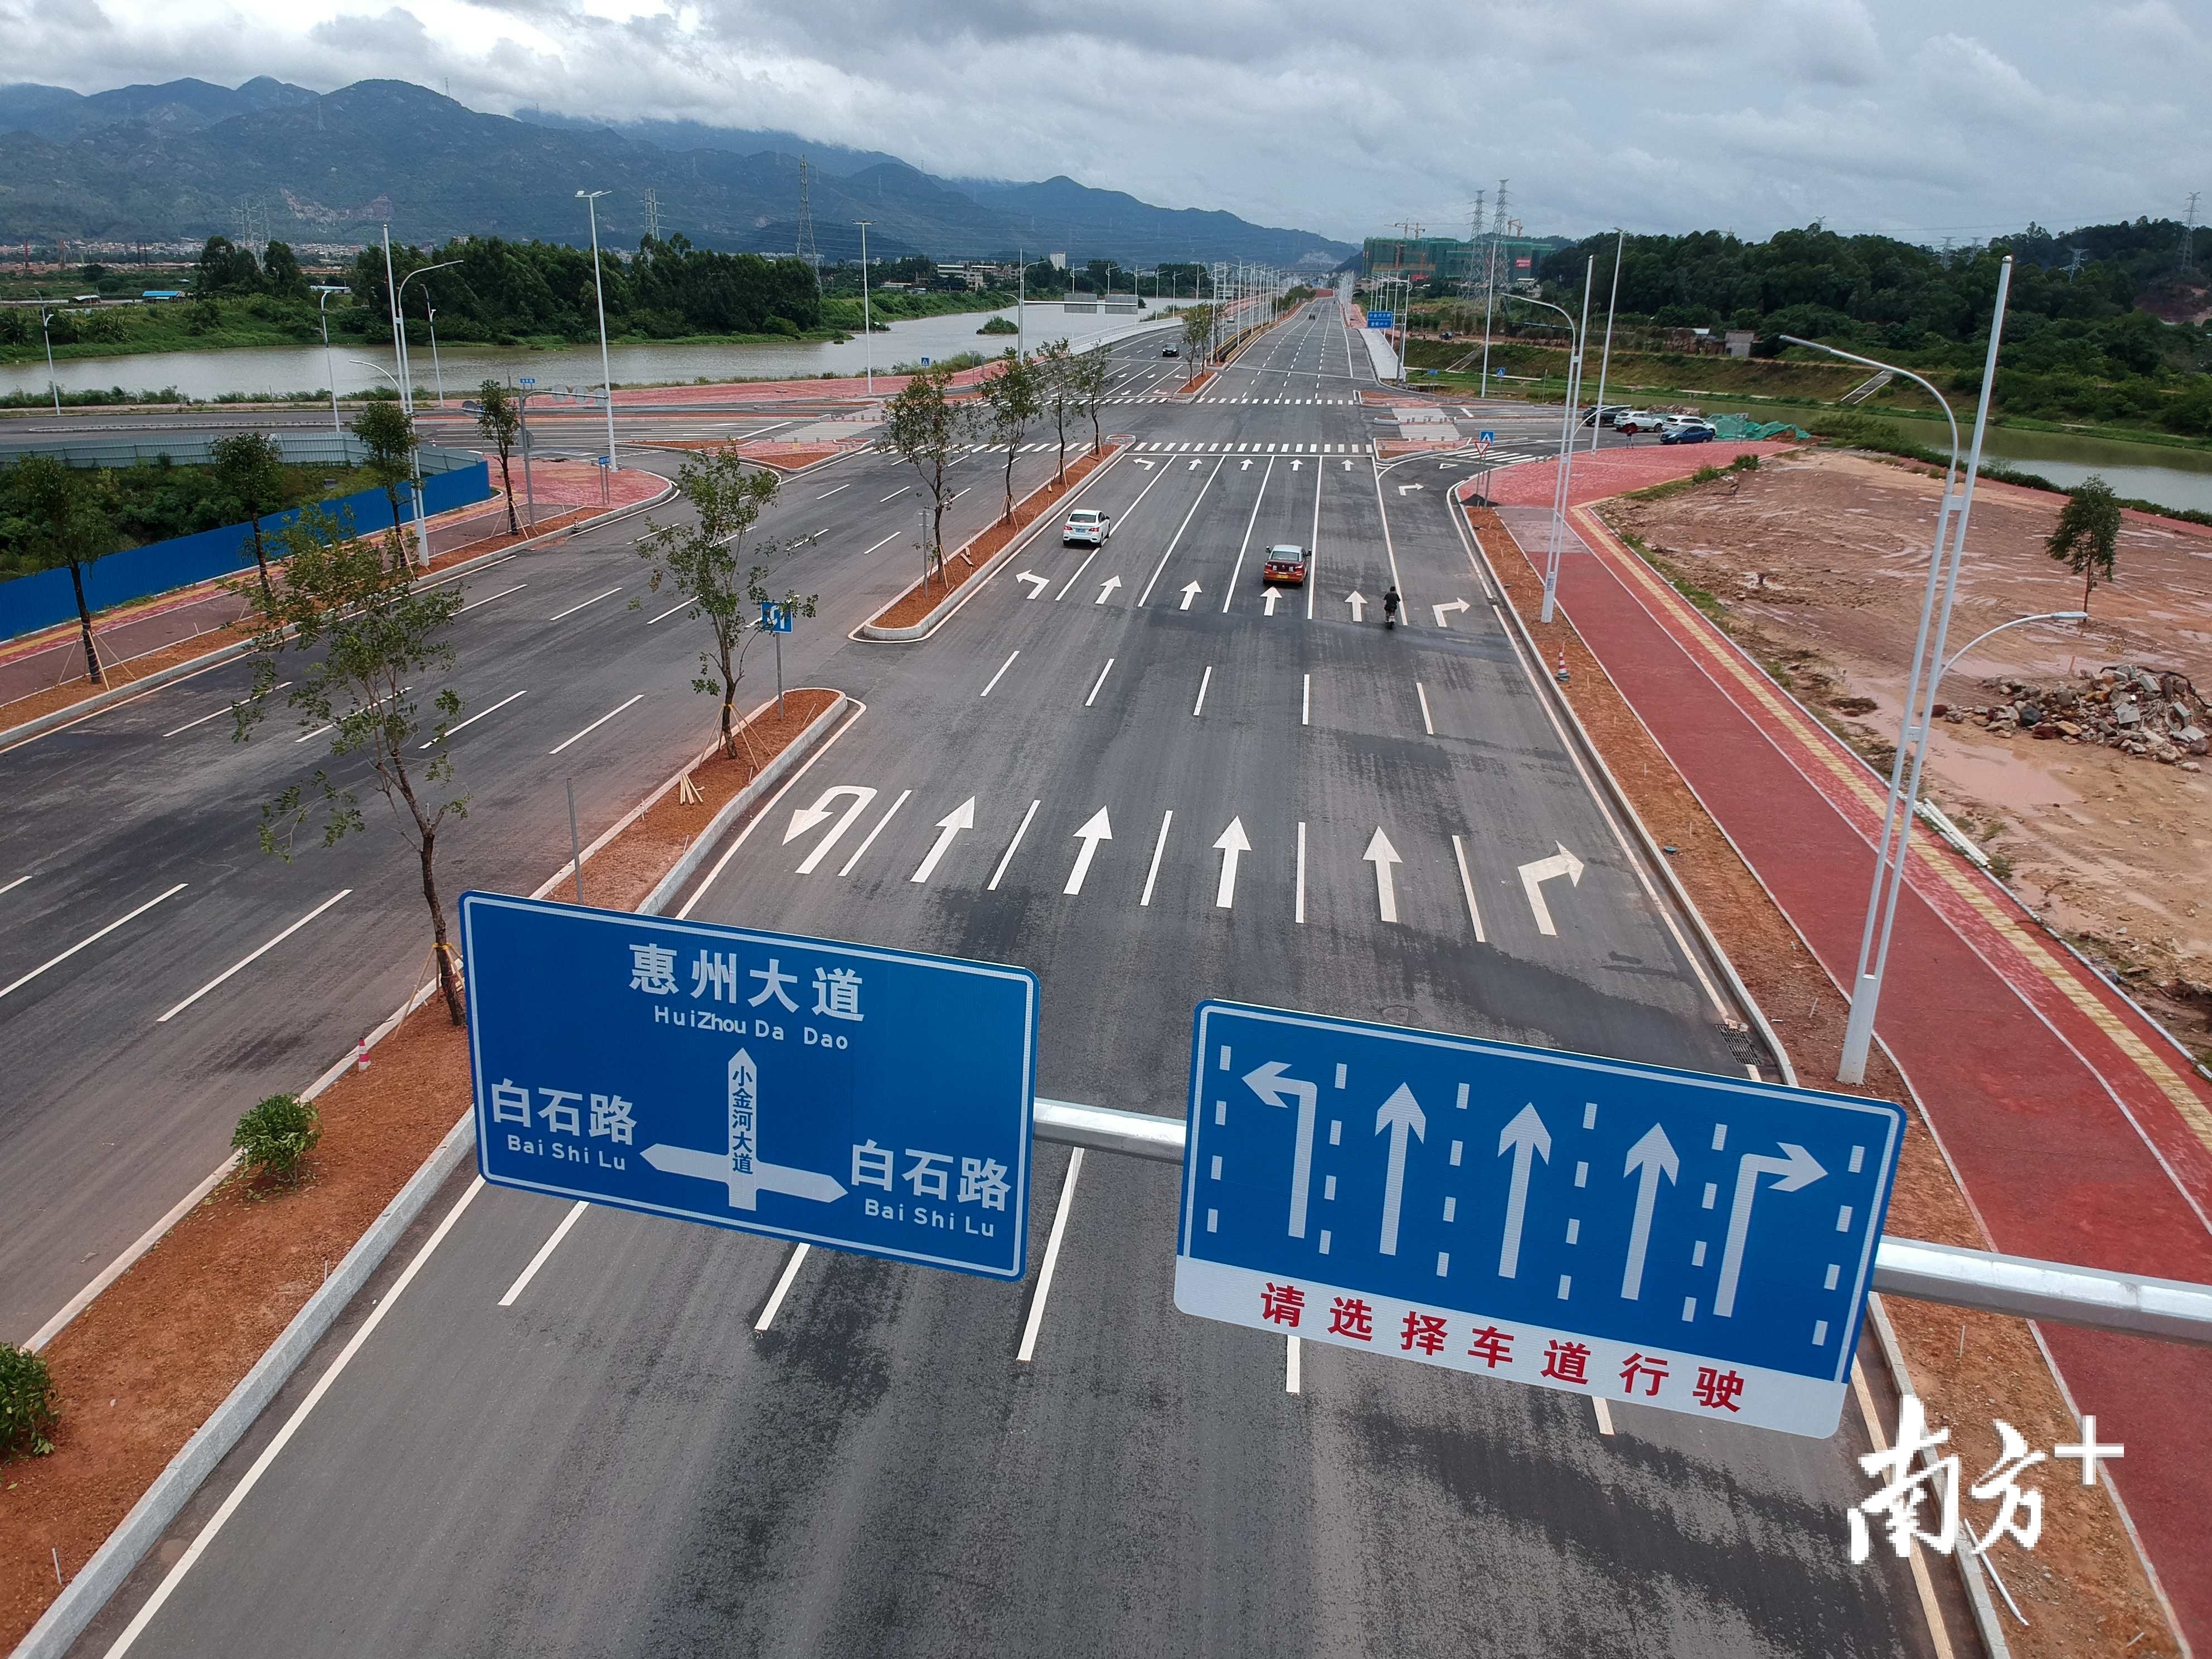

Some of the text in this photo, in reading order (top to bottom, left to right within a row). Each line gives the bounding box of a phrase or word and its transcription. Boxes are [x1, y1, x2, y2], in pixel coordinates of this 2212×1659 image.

[629, 943, 865, 1022] 惠州大道
[654, 1005, 848, 1050] HuiZhou Da Dao
[491, 1078, 637, 1146] 白石路
[732, 1065, 753, 1175] 小金河大道
[507, 1134, 625, 1170] Bai Shi Lu
[851, 1139, 1011, 1212] 白石路
[865, 1199, 994, 1237] Bai Shi Lu
[1260, 1283, 1745, 1413] 请选择车道行驶
